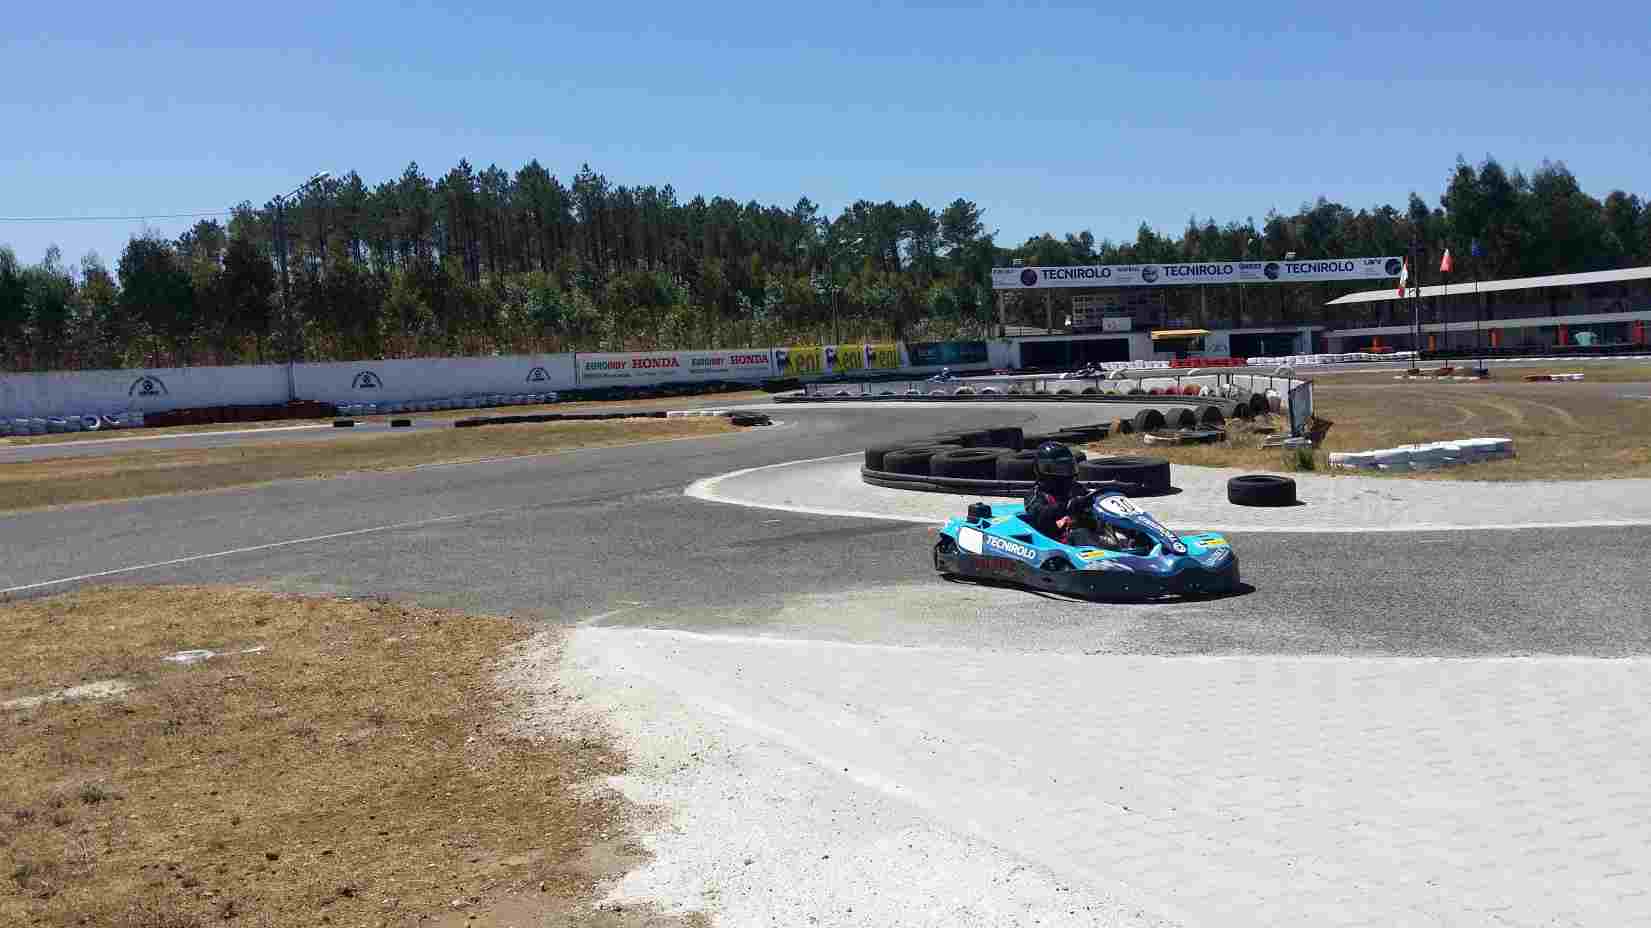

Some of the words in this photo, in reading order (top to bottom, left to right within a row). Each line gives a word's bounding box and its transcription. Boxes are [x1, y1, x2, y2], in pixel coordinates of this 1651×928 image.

[1041, 267, 1111, 280] TECNIROLO
[1164, 263, 1233, 277] TECNIROLO
[1285, 261, 1354, 274] TECNIROLO
[632, 356, 680, 369] HONDA
[729, 354, 768, 365] HONDA
[986, 535, 1036, 559] TECNIROLO
